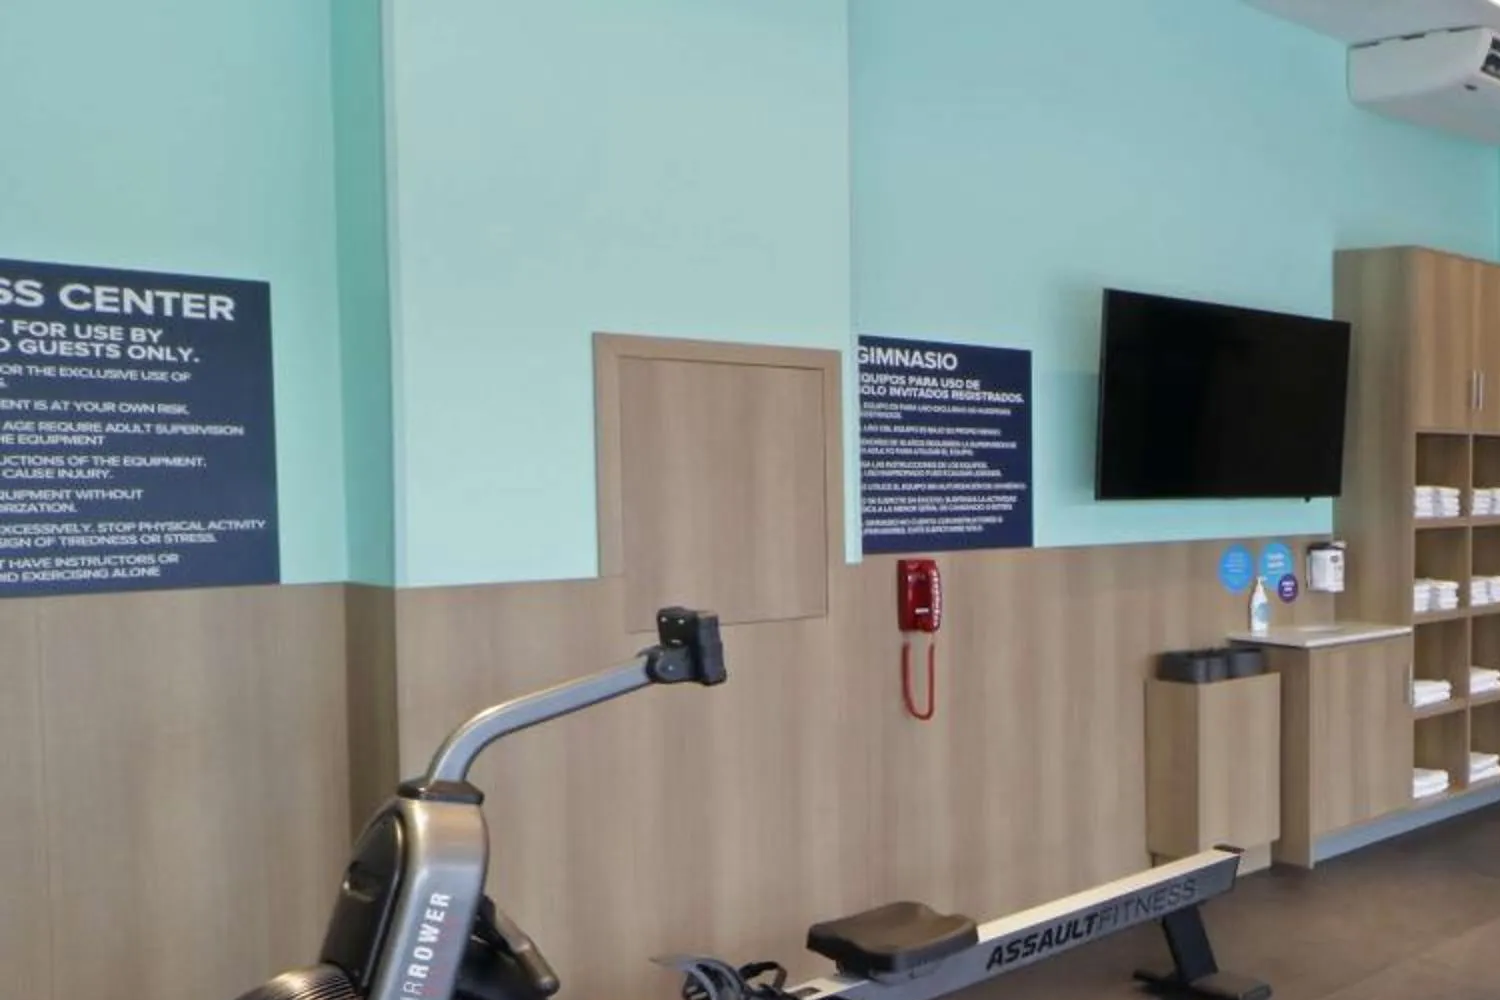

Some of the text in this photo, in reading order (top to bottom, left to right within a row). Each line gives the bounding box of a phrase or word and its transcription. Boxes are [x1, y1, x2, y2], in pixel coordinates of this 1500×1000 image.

[59, 283, 235, 321] CENTER
[13, 320, 66, 338] FOR
[74, 323, 124, 341] USE
[131, 327, 163, 344] BY
[18, 339, 121, 359] GUESTS
[128, 345, 200, 363] ONLY.
[857, 345, 958, 371] GIMNASIO
[26, 365, 56, 377] THE
[59, 366, 139, 381] EXCLUSIVE
[141, 370, 169, 382] USE
[908, 376, 938, 388] PARA
[940, 378, 964, 389] USO
[965, 379, 981, 390] DE
[889, 386, 949, 400] INVITADOS
[951, 391, 1025, 404] REGISTRADOS.
[33, 399, 48, 411] IS
[50, 400, 70, 411] AT
[71, 400, 117, 413] YOUR
[119, 402, 155, 414] OWN
[3, 420, 245, 436] AGE REQUIRE ADULT SUPERVISION
[17, 433, 105, 446] EQUIPMENT
[67, 455, 89, 467] OF
[91, 455, 121, 467] THE
[2, 467, 114, 479] CAUSE INJURY.
[74, 489, 144, 501] WITHOUT
[97, 521, 136, 533] STOP
[138, 521, 206, 533] PHYSICAL
[208, 519, 266, 530] ACTIVITY
[34, 535, 57, 547] OF
[58, 533, 138, 546] TIREDNESS
[140, 533, 161, 545] OR
[8, 557, 53, 569] HAVE
[55, 553, 156, 568] INSTRUCTORS
[158, 552, 180, 564] OR
[22, 568, 109, 582] EXERCISING
[111, 566, 160, 579] ALONE
